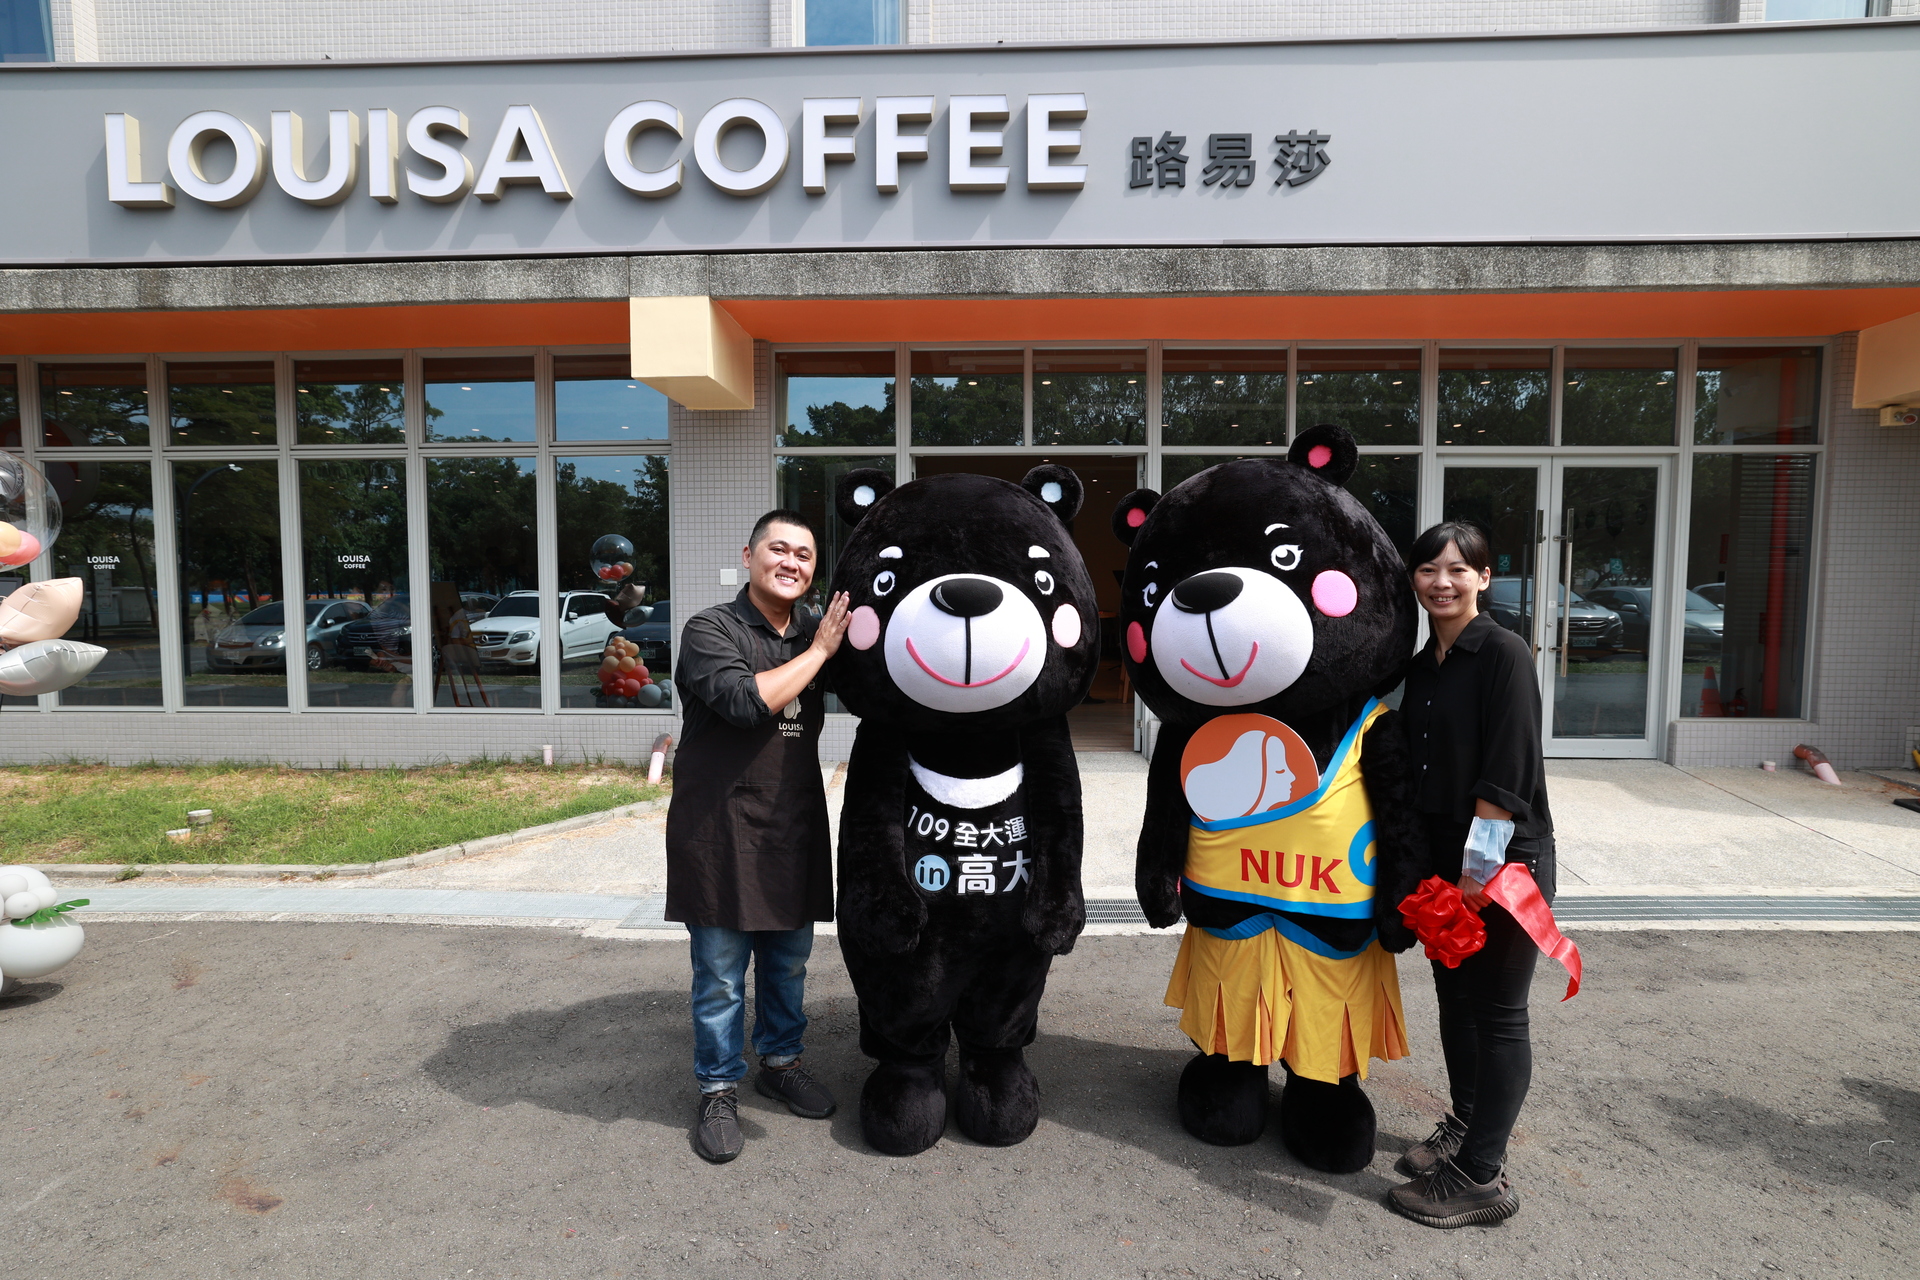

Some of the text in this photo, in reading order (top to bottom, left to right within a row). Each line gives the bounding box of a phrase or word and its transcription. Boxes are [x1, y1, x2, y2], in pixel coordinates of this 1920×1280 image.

[104, 93, 1089, 208] LOUISA COFFEE
[1130, 129, 1331, 189] 路易莎
[87, 555, 120, 564] LOUISA
[337, 555, 371, 563] LOUISA
[778, 722, 804, 731] LOUISA
[1240, 848, 1343, 894] NUK
